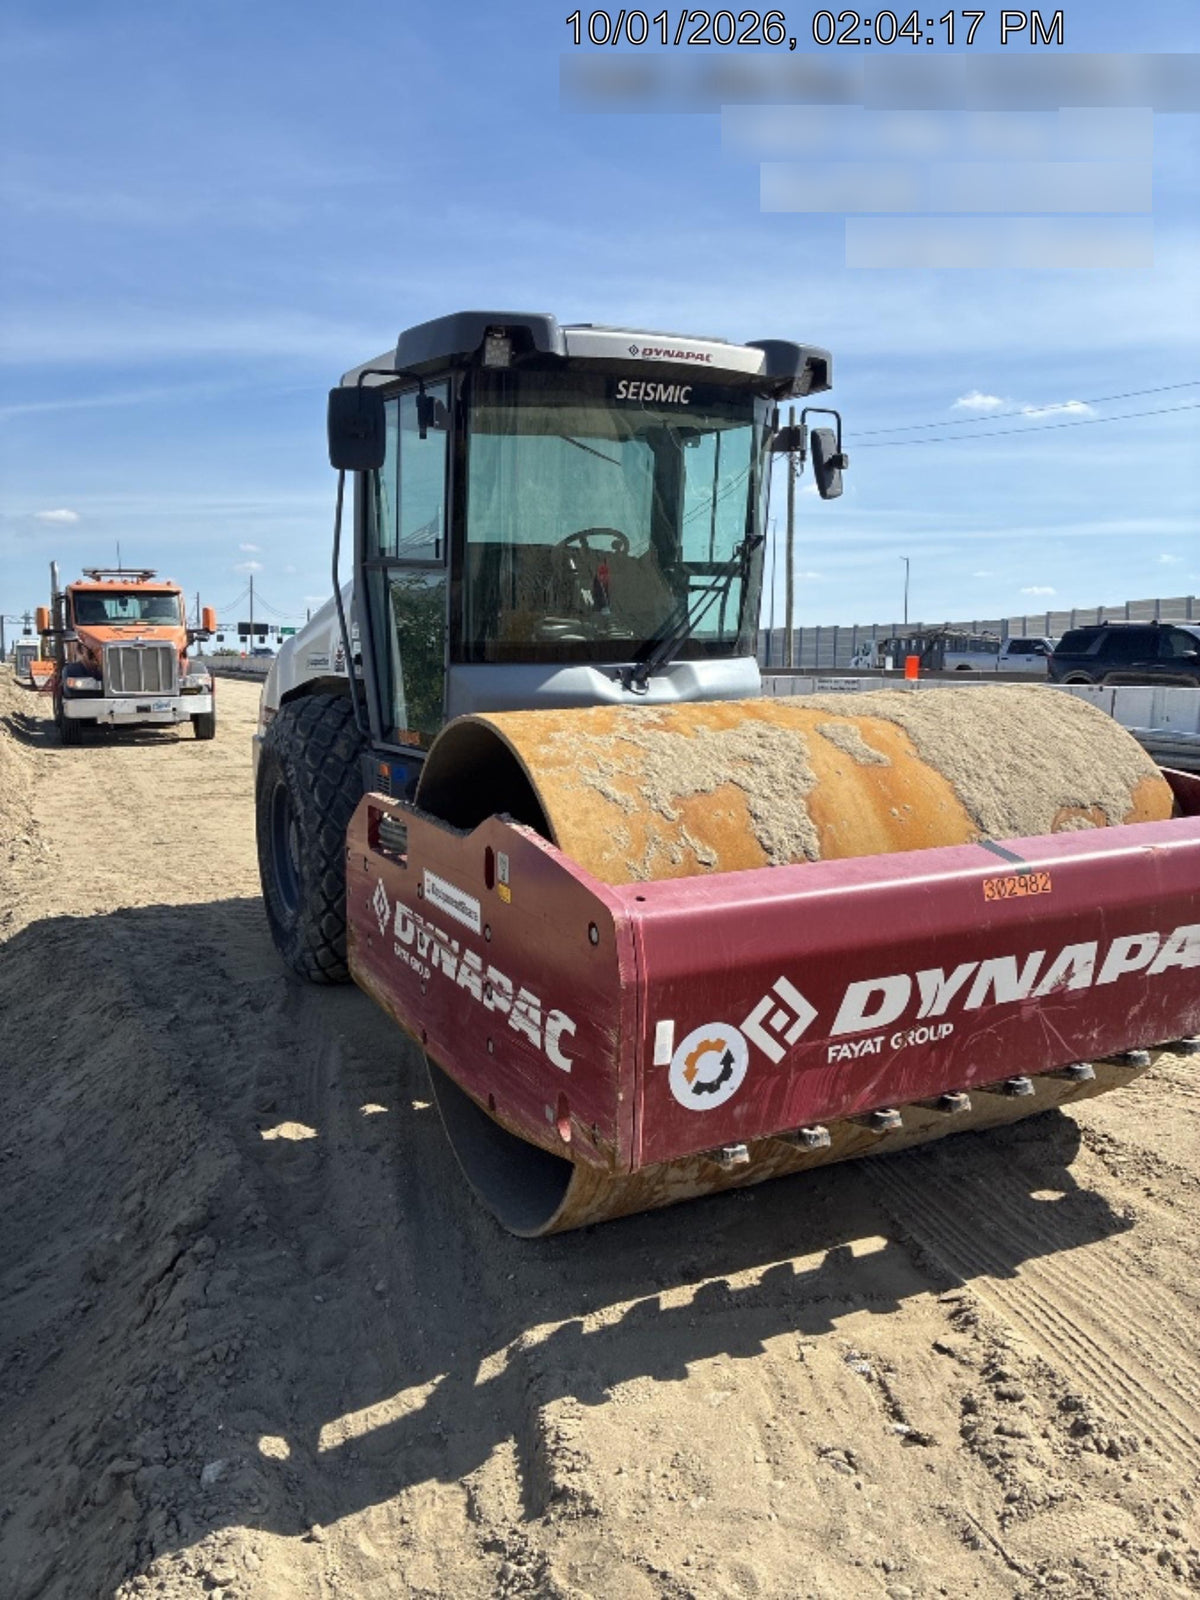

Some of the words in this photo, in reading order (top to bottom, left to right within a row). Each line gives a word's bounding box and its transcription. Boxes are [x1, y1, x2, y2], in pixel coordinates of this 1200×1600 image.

[642, 347, 713, 363] DYNAPAC
[616, 380, 693, 404] SEISMIC
[984, 872, 1050, 899] 302982
[394, 900, 577, 1074] DYNAPAC
[828, 1036, 885, 1064] FAYAT
[890, 1022, 954, 1050] GROUP
